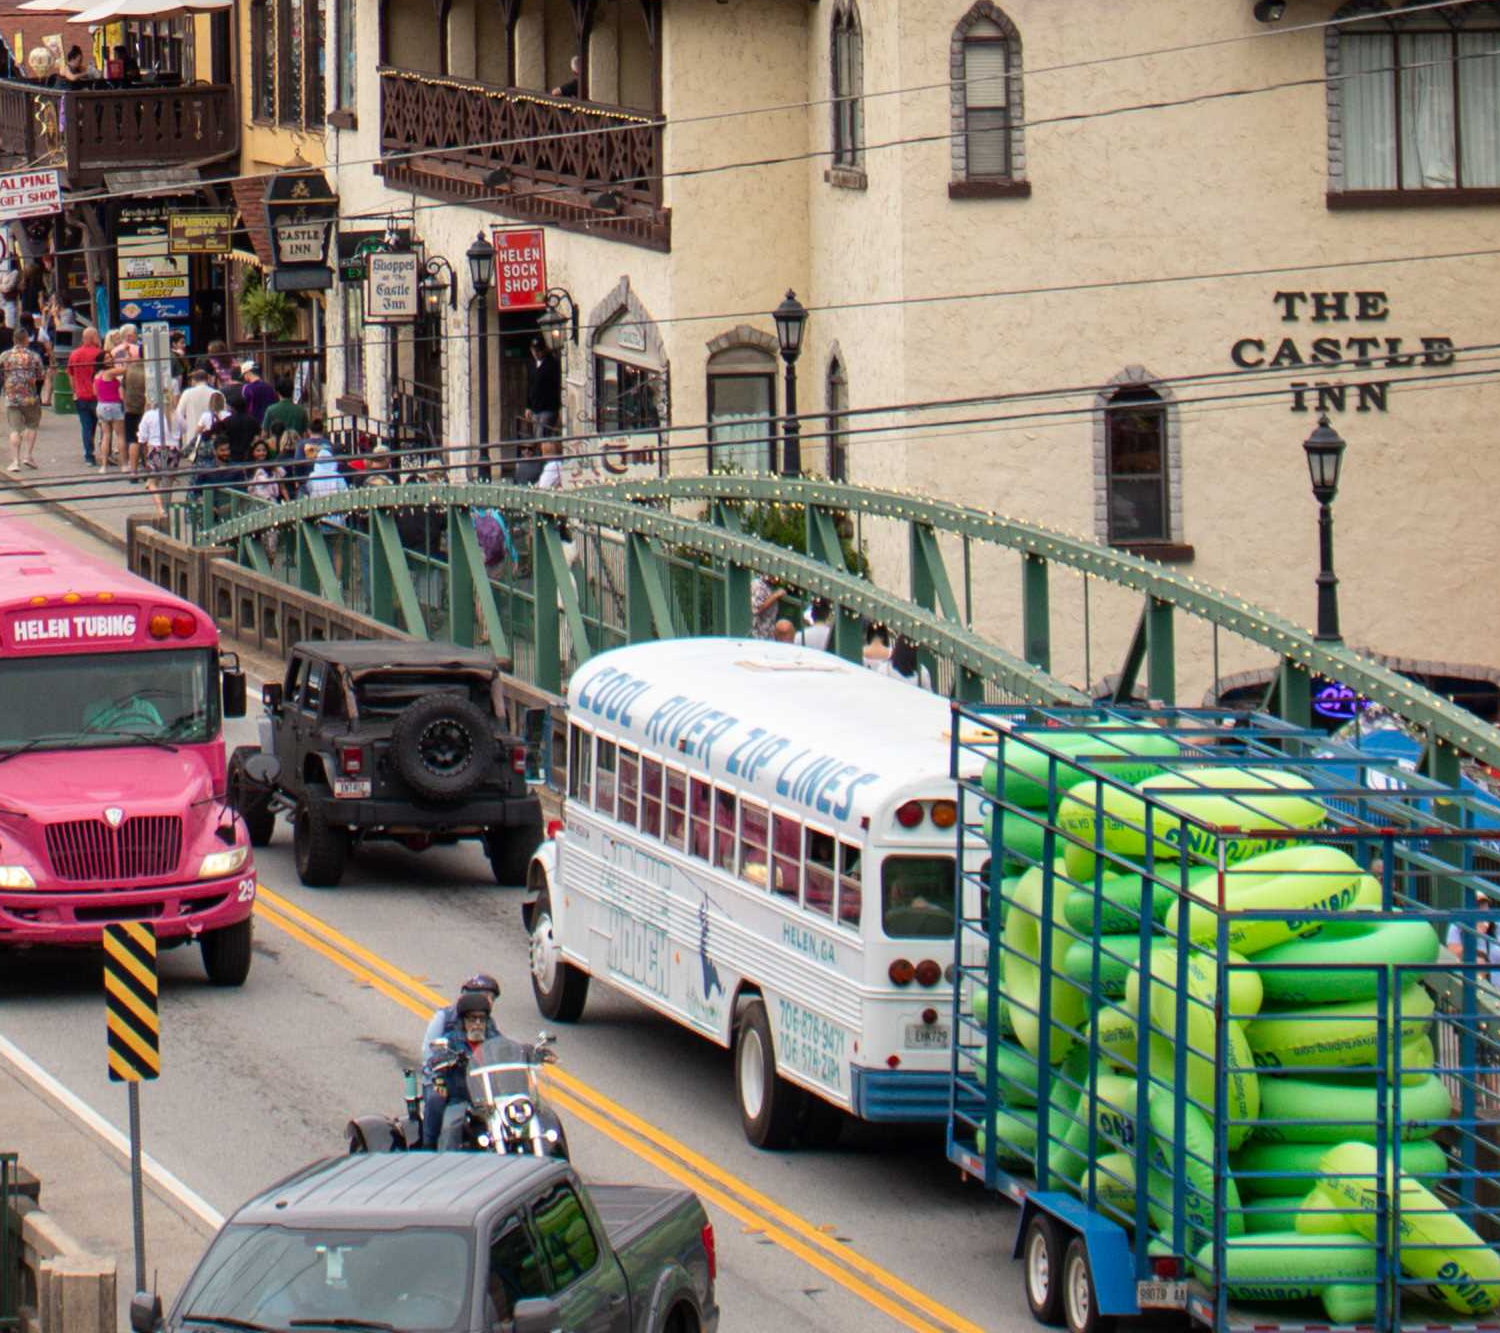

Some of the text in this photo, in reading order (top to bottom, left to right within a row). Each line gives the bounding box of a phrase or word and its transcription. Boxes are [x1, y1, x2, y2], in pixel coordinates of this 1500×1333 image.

[0, 174, 56, 192] ALPINE
[0, 190, 58, 207] GIFT SHOP
[279, 230, 320, 241] CASTLE
[290, 244, 312, 255] INN
[499, 247, 541, 263] HELEN
[373, 260, 415, 273] Shoppes
[503, 264, 538, 278] SOCK
[376, 283, 410, 296] Castle
[504, 277, 539, 293] SHOP
[383, 297, 407, 310] Inn
[1273, 290, 1390, 323] THE
[1230, 337, 1456, 368] CASTLE
[1290, 381, 1390, 413] INN
[13, 613, 137, 642] HELEN TUBING
[578, 666, 881, 823] COOL RIVER ZIP LINES
[237, 879, 256, 903] 29
